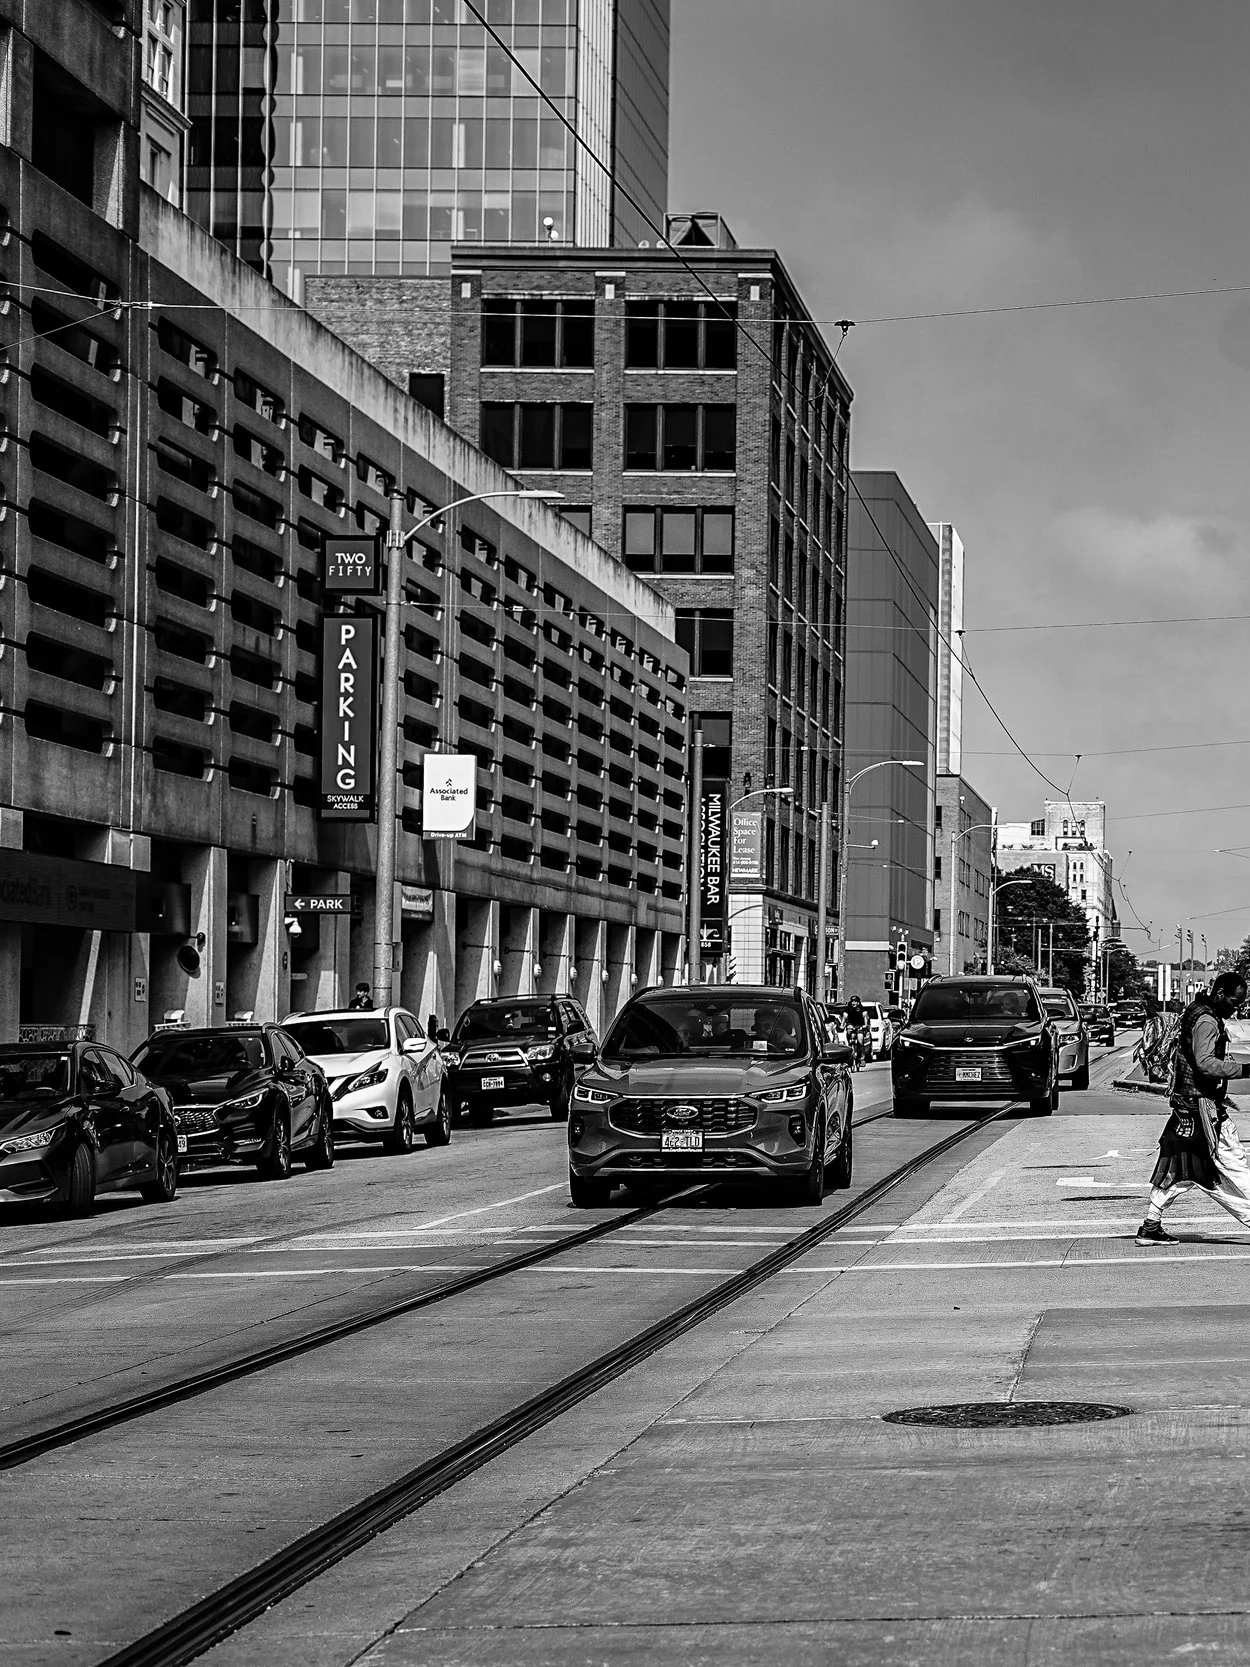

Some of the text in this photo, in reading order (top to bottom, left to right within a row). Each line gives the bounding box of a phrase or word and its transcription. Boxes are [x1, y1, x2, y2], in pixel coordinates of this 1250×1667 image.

[335, 553, 366, 564] TWO
[329, 566, 371, 576] FIFTY
[336, 625, 357, 790] PARKING
[734, 818, 757, 826] Office
[734, 827, 756, 837] Space
[707, 794, 721, 905] MILWAUKEE BAR
[310, 899, 343, 909] PARK
[674, 1108, 691, 1116] Ford
